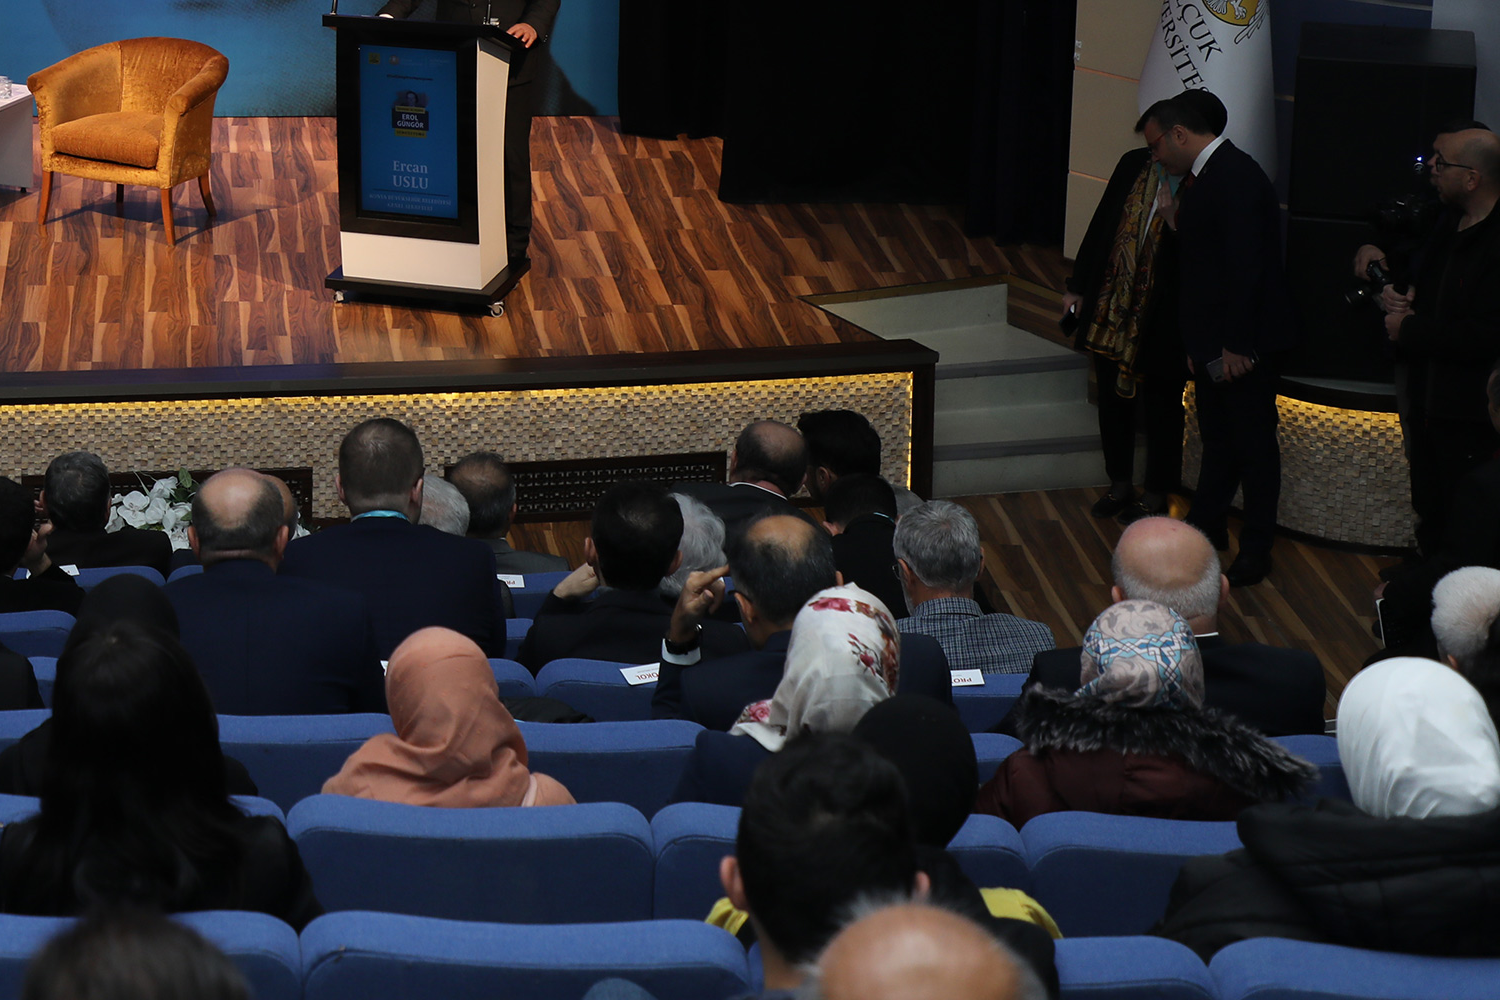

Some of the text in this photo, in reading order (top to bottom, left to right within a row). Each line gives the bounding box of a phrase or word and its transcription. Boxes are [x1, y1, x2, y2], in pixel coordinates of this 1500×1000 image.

[401, 113, 419, 121] EROL
[396, 120, 424, 129] GÜNGÖR
[392, 160, 428, 174] Ercan
[392, 175, 429, 190] USLU
